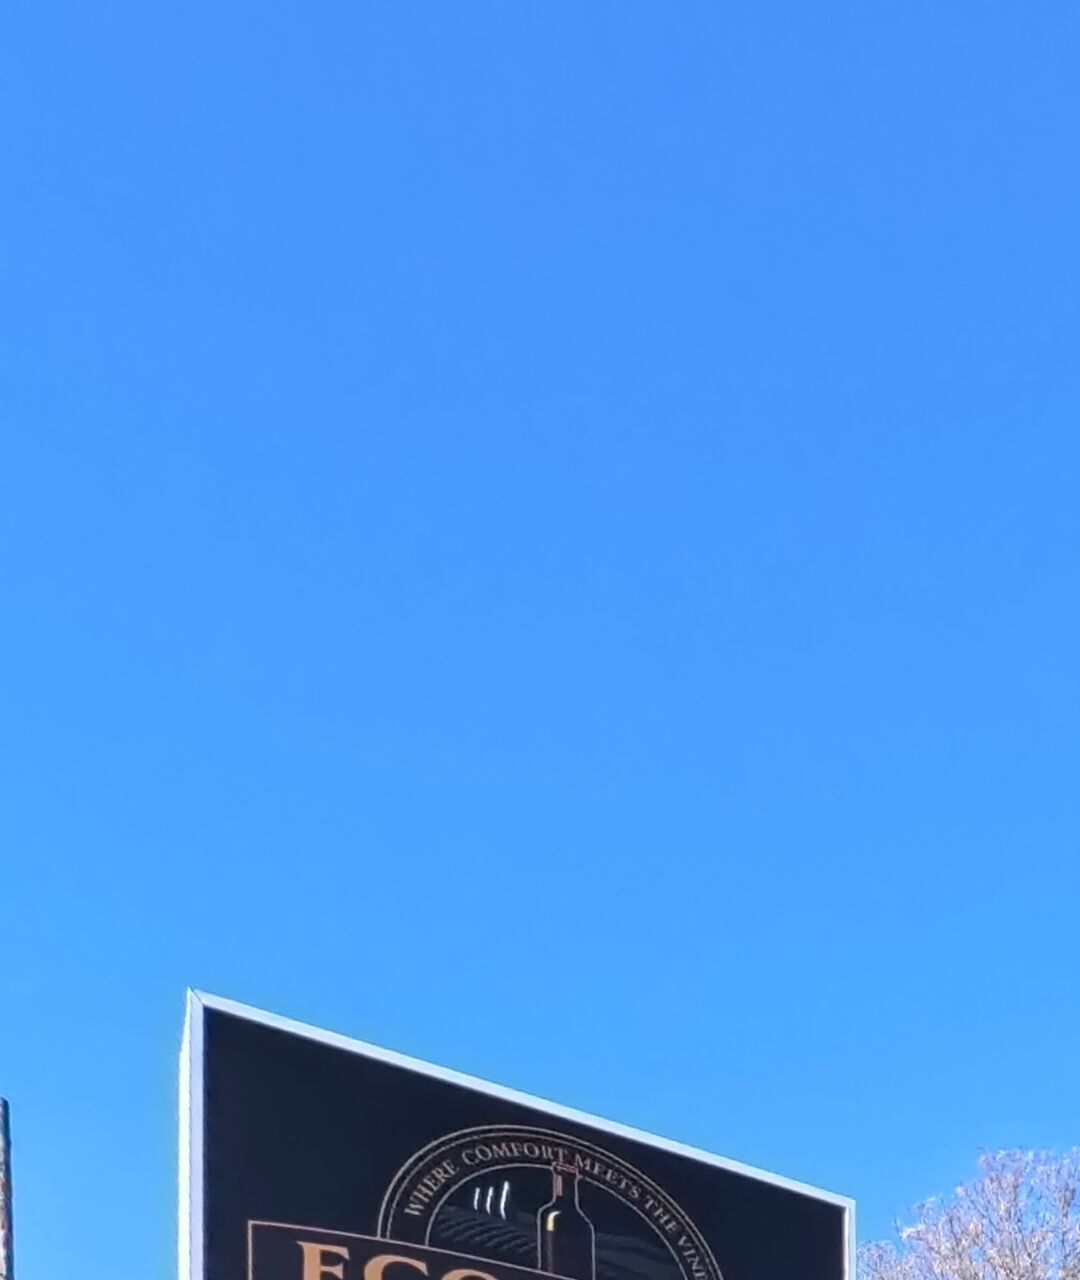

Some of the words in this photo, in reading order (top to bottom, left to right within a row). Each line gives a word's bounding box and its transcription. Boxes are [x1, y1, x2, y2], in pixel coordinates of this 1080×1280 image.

[404, 1159, 460, 1216] WHERE
[461, 1142, 567, 1166] COMFORT
[575, 1153, 640, 1199] MEETS
[643, 1196, 680, 1234] THE
